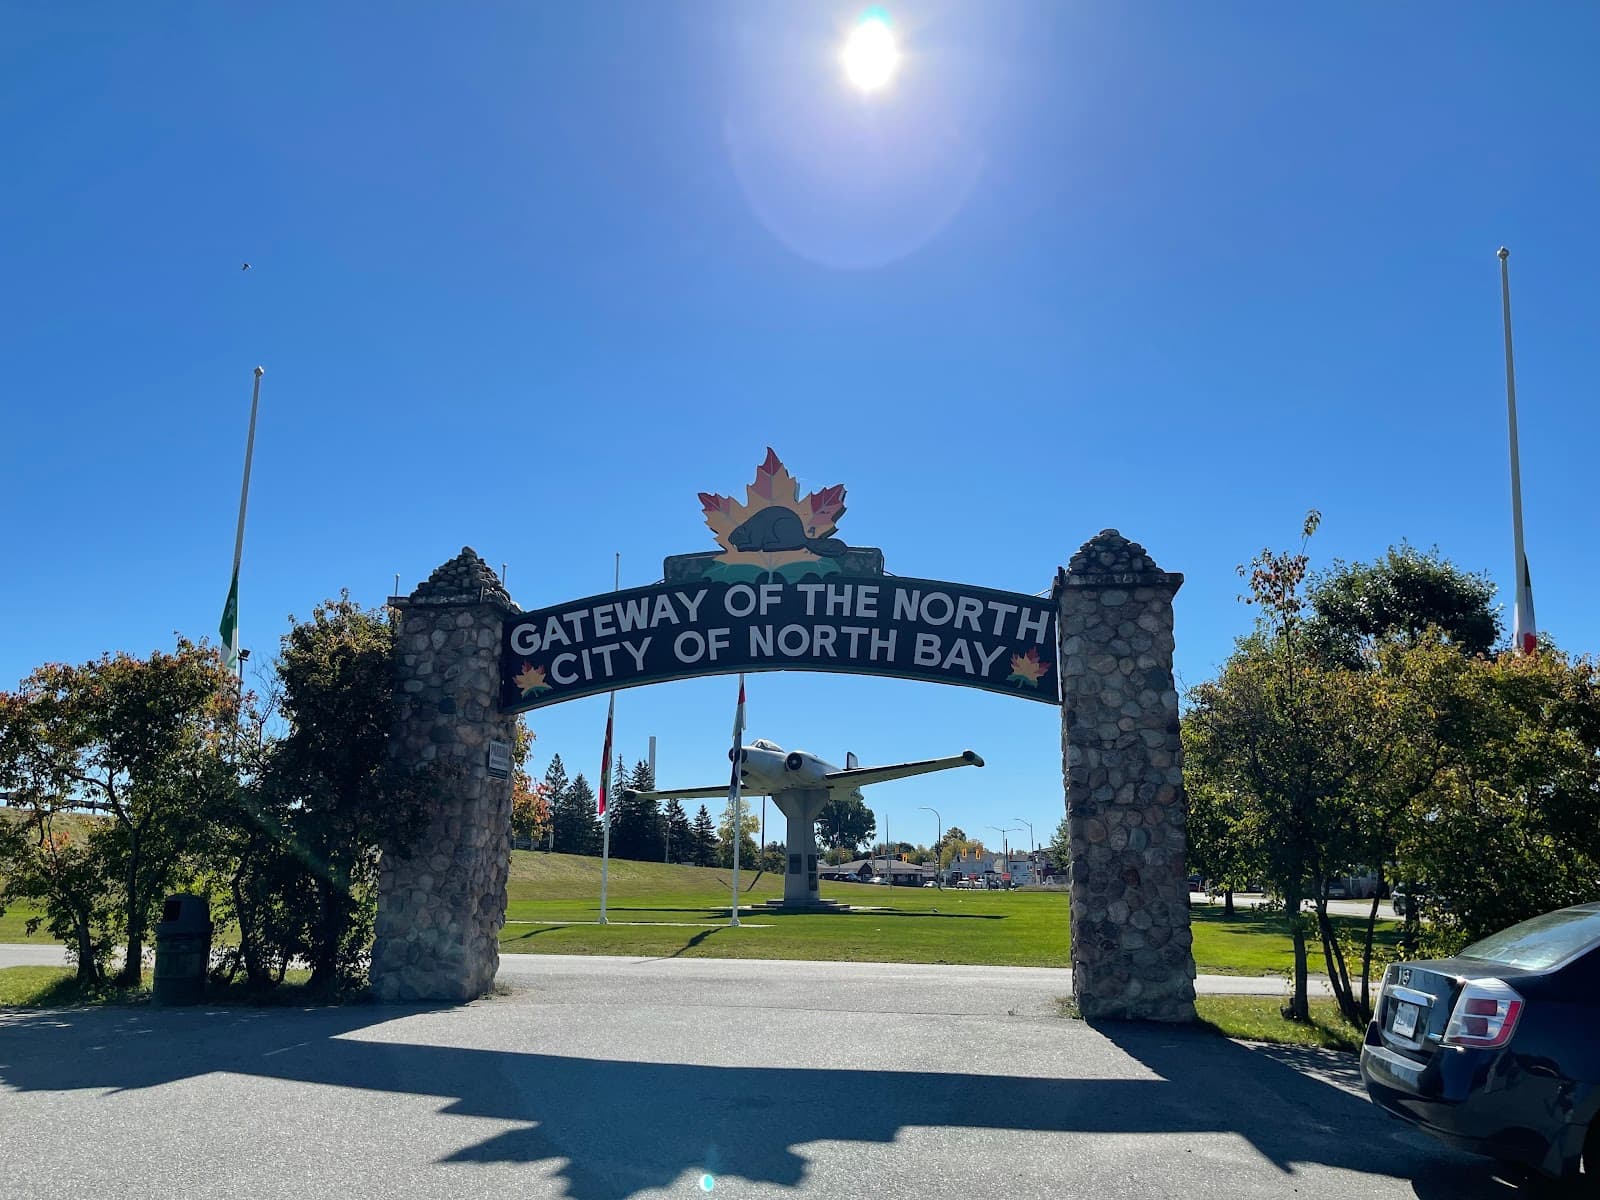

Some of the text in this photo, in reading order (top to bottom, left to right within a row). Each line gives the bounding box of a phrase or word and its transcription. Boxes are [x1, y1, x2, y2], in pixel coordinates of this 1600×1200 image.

[510, 584, 1050, 657] GATEWAY OF THE NORTH
[551, 623, 1007, 685] CITY OF NORTH BAY
